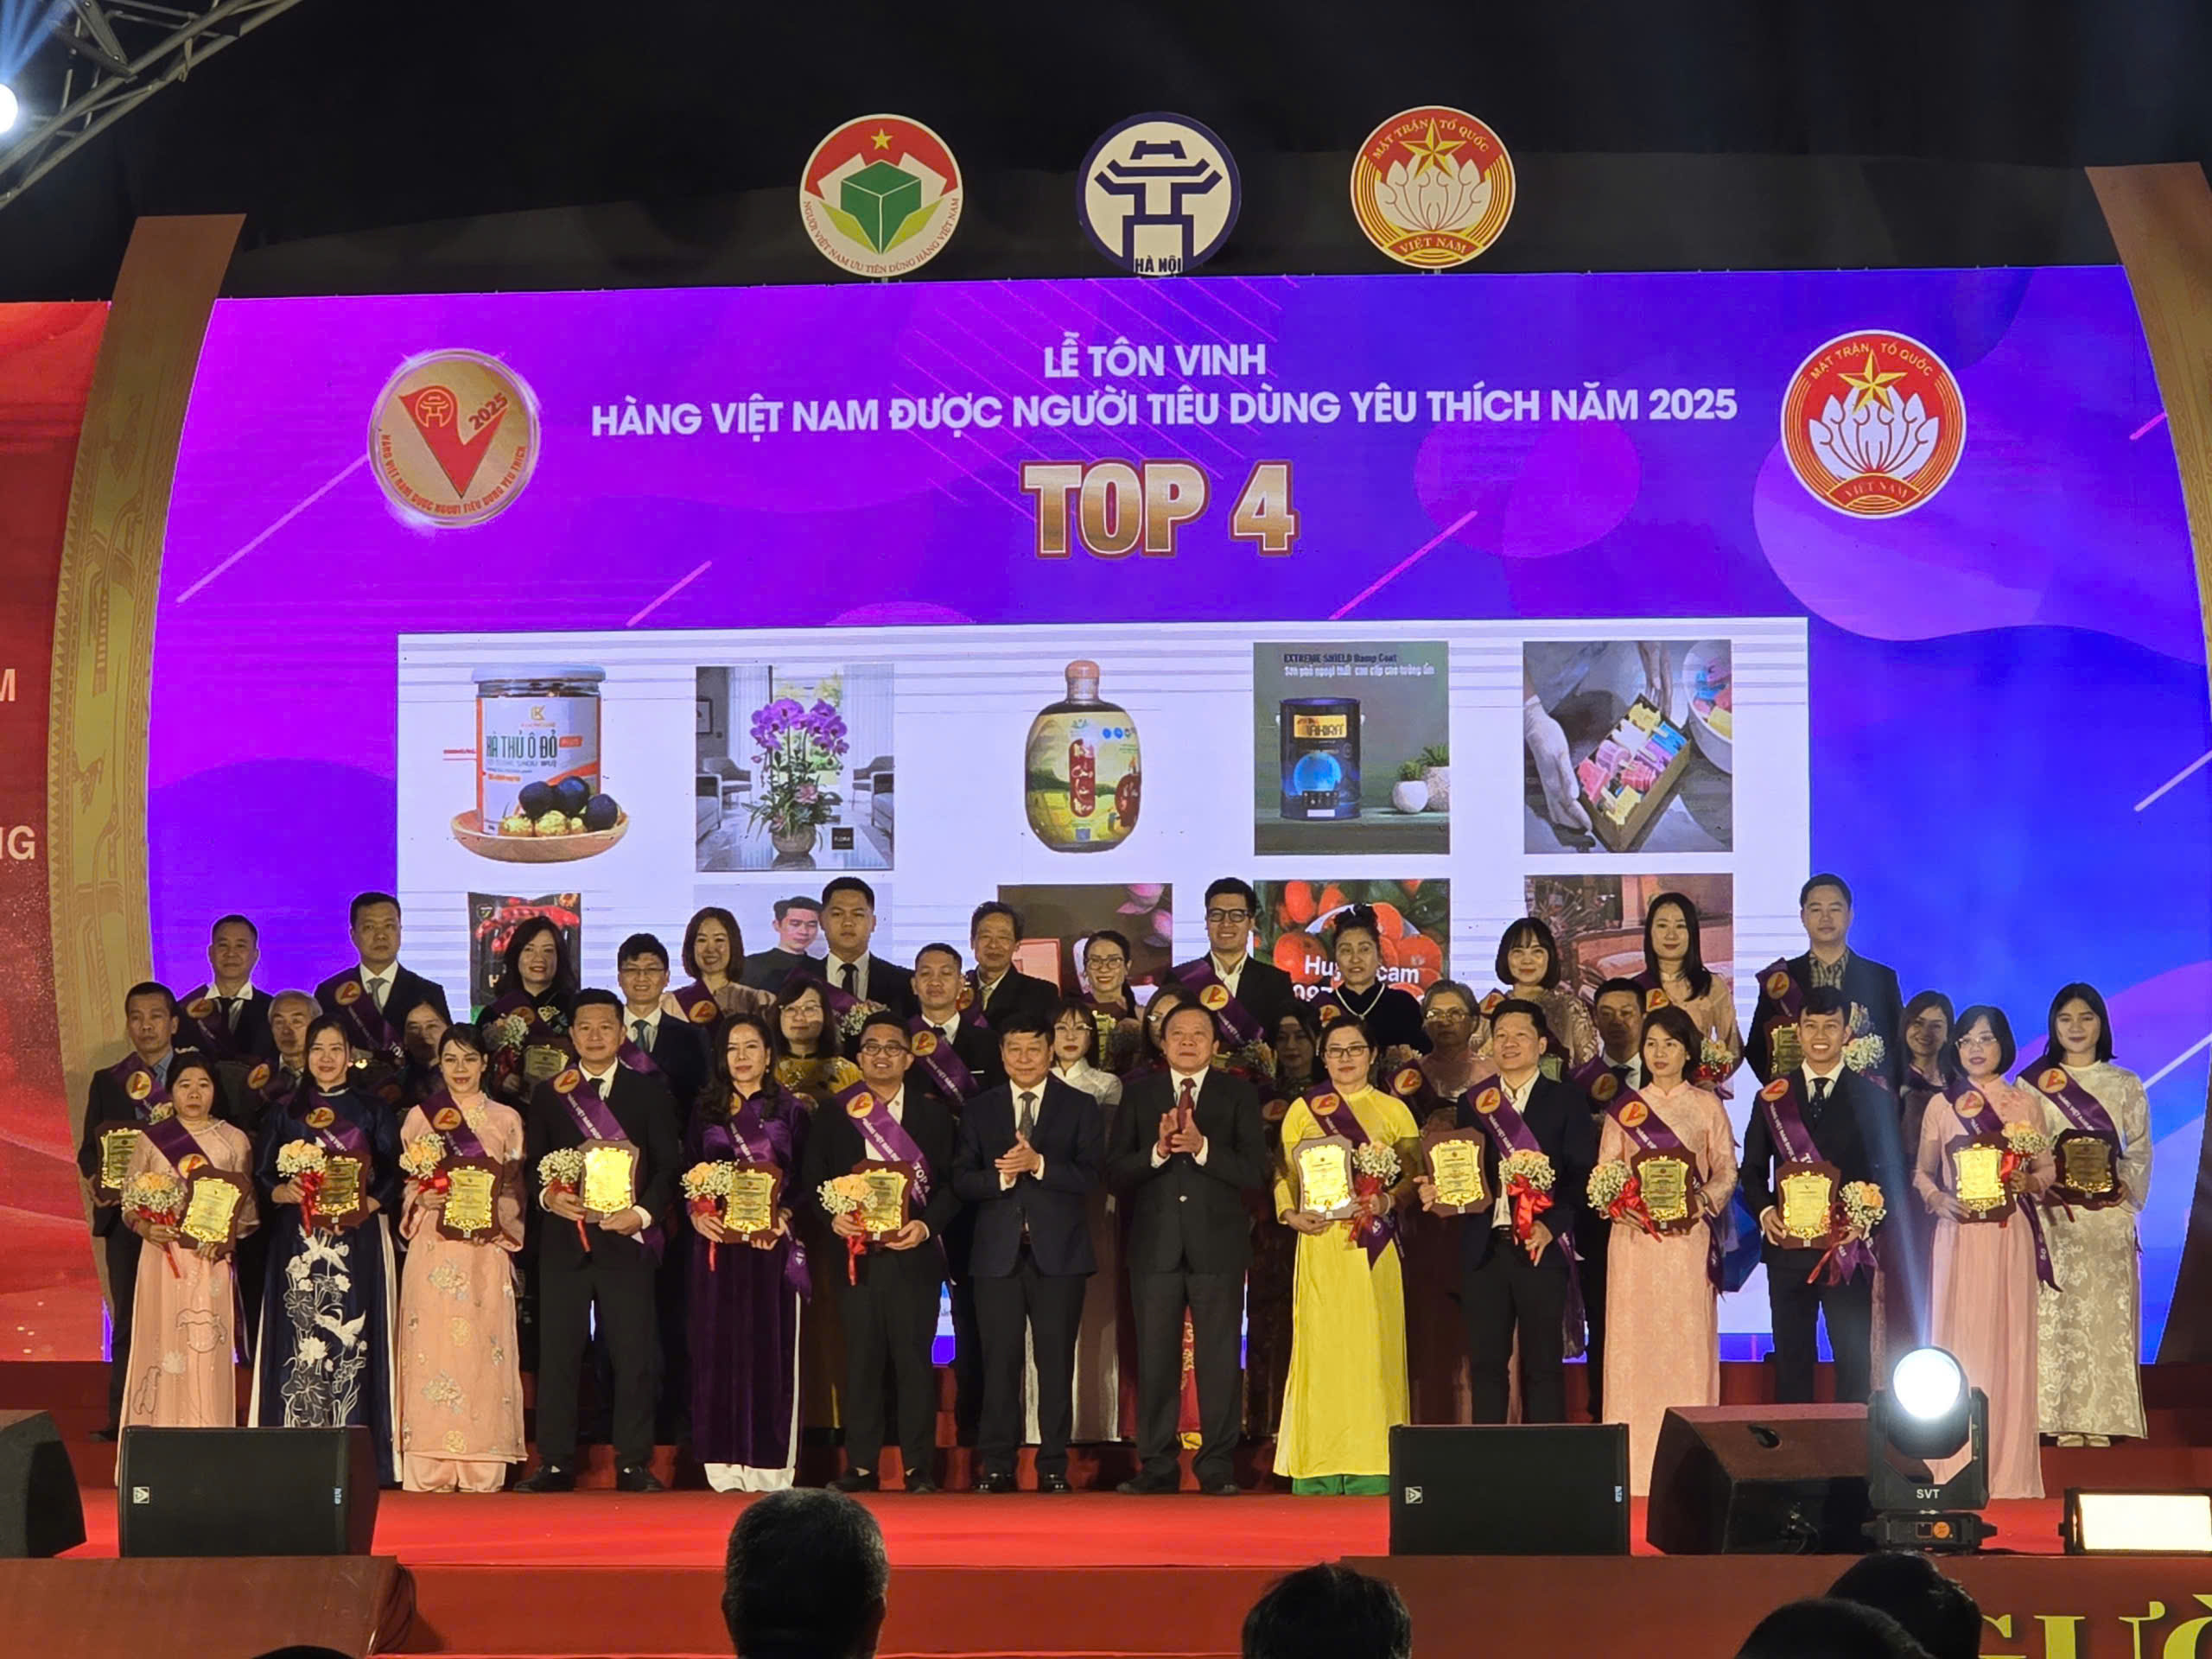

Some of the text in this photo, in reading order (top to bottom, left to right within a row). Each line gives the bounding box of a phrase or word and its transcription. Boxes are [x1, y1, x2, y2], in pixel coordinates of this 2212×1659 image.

[1373, 136, 1393, 159] MẶT
[1394, 118, 1428, 137] TRẬN
[1459, 126, 1490, 153] QUỐC
[829, 247, 849, 266] NAM
[949, 197, 960, 221] NAM
[1400, 237, 1467, 254] VIỆT NAM
[1135, 254, 1181, 274] HÀ NỘI
[1044, 332, 1266, 378] LỄ TÔN VINH
[1810, 355, 1834, 381] MẶT
[1835, 342, 1870, 359] TRẬN
[468, 392, 508, 430] 2025
[592, 381, 1738, 442] HÀNG VIỆT NAM ĐƯỢC NGƯỜI TIÊU DÙNG YÊU THÍCH NĂM 2025
[1020, 459, 1300, 559] TOP 4
[486, 729, 557, 759] HÀ THỦ Ô ĐỎ
[1376, 966, 1419, 984] cam
[1916, 1489, 1940, 1499] SVT
